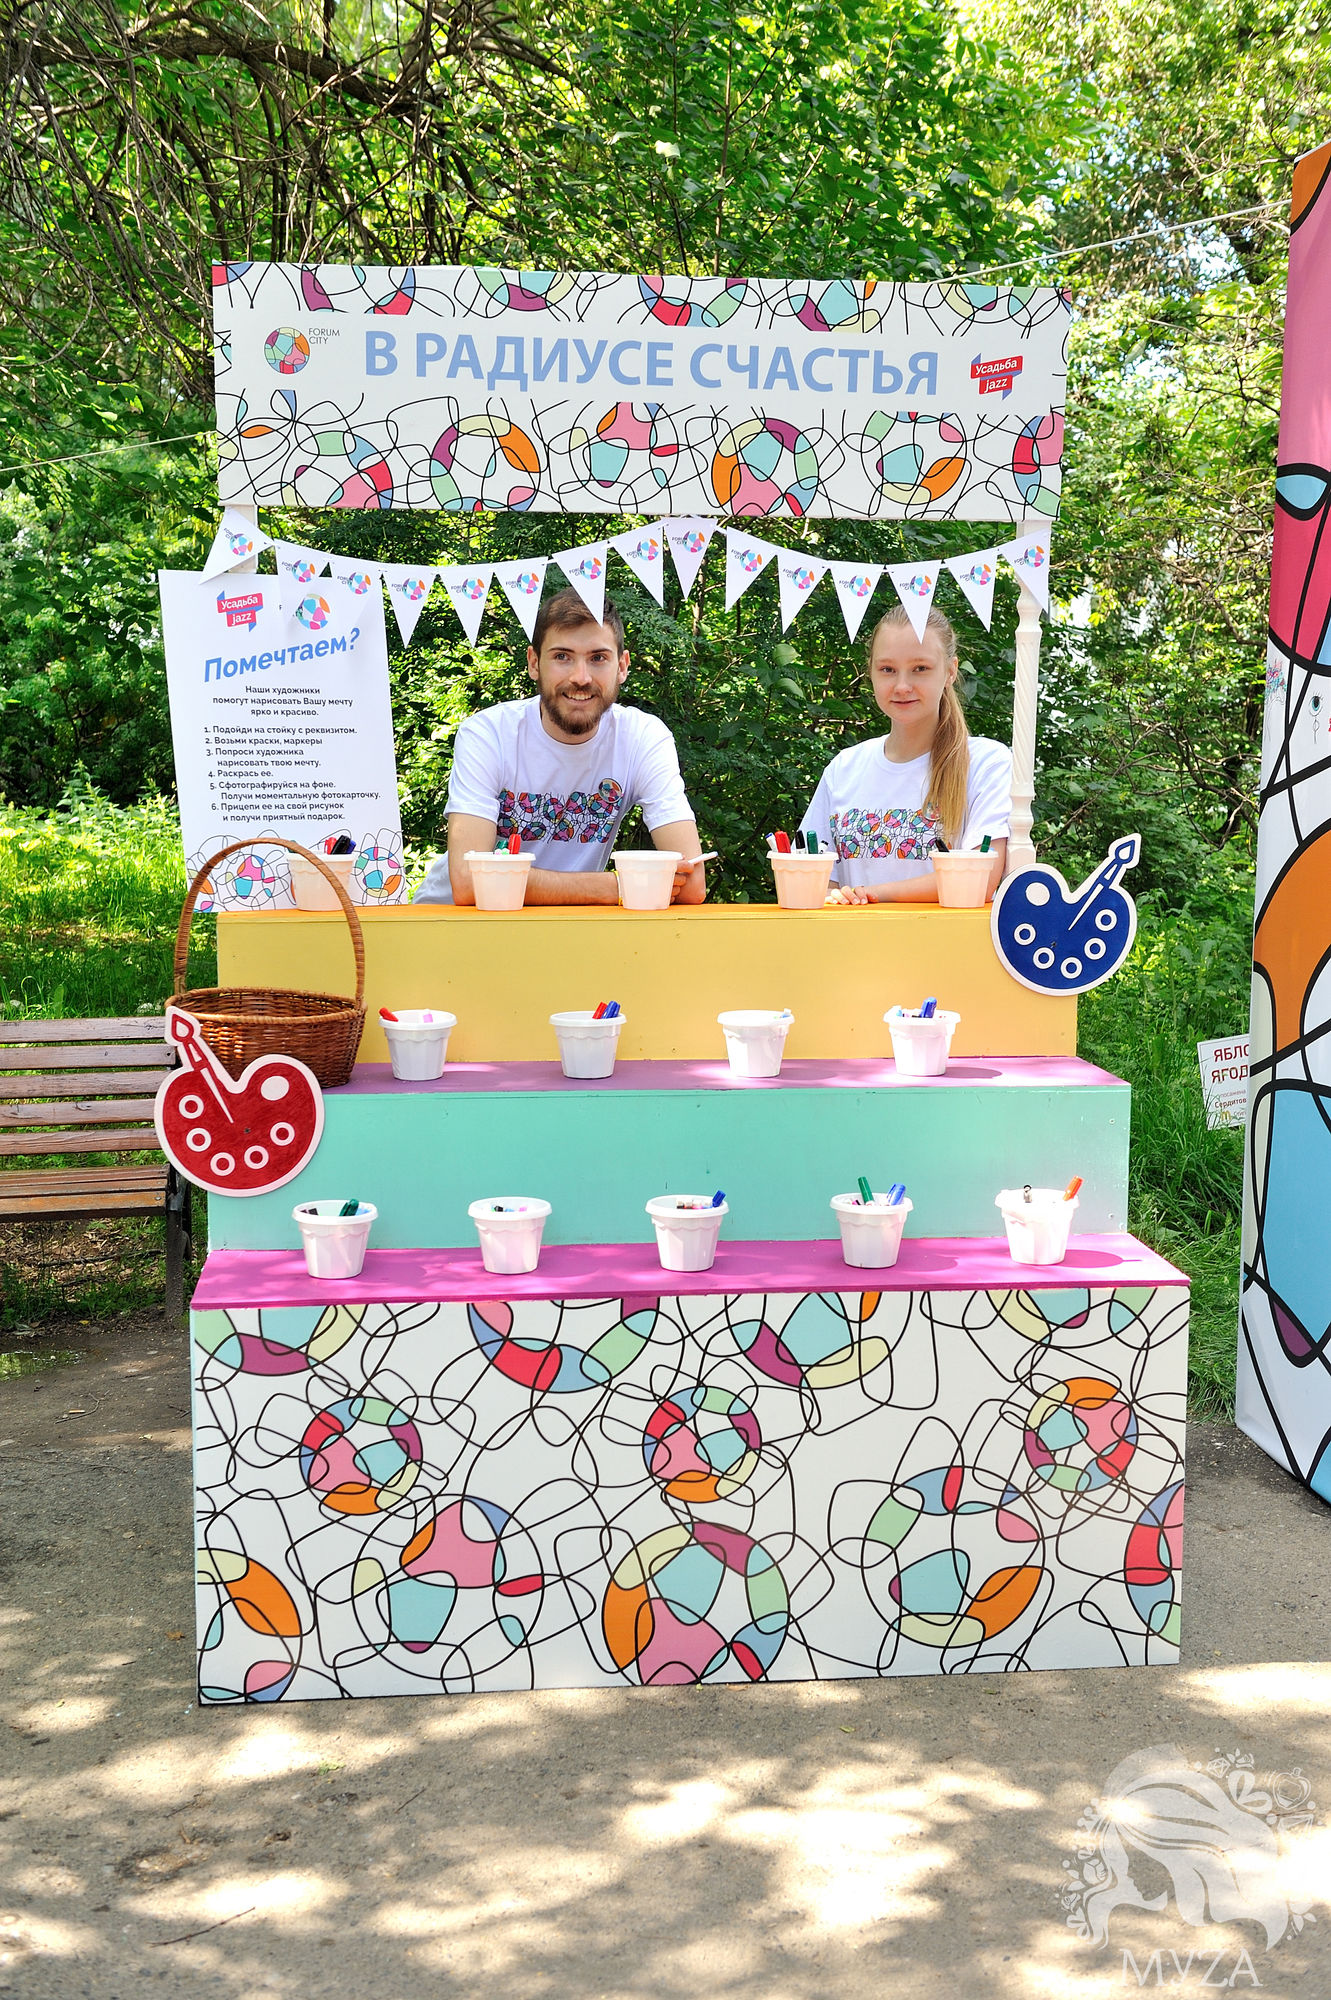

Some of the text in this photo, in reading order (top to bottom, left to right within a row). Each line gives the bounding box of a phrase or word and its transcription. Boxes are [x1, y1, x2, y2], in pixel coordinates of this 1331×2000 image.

[308, 327, 341, 336] FORUM
[308, 336, 329, 345] CITY
[366, 331, 938, 396] В РАДИУСЕ СЧАСТЬЯ
[975, 359, 1018, 376] Усадьба
[984, 378, 1008, 394] jazz
[220, 596, 258, 610] Усадьба
[231, 613, 252, 626] jazz
[204, 627, 360, 683] Помечтаем?
[245, 685, 321, 696] Наши художники
[212, 697, 353, 708] помогут нарисовать Вашу мечту
[250, 708, 272, 717] ярко
[280, 709, 320, 717] красиво.
[212, 725, 253, 735] Подойди
[266, 725, 297, 736] стойку
[304, 727, 358, 736] реквизитом.
[205, 736, 323, 747] 2. Возьми краски, маркеры
[206, 747, 305, 758] 3. Попроси художника
[217, 760, 269, 769] нарисовать
[294, 759, 322, 769] мечту.
[217, 769, 260, 779] Раскрась
[209, 782, 217, 791] 5.
[218, 780, 299, 791] Сфотографируйся
[311, 780, 337, 790] фоне.
[221, 791, 382, 802] Получи моментальную фотокарточку.
[211, 802, 220, 811] 6.
[221, 802, 260, 813] Прицепи
[286, 801, 308, 810] свой
[308, 803, 345, 811] рисунок
[230, 815, 262, 824] получи
[262, 813, 306, 823] приятный
[307, 813, 346, 821] подарок.
